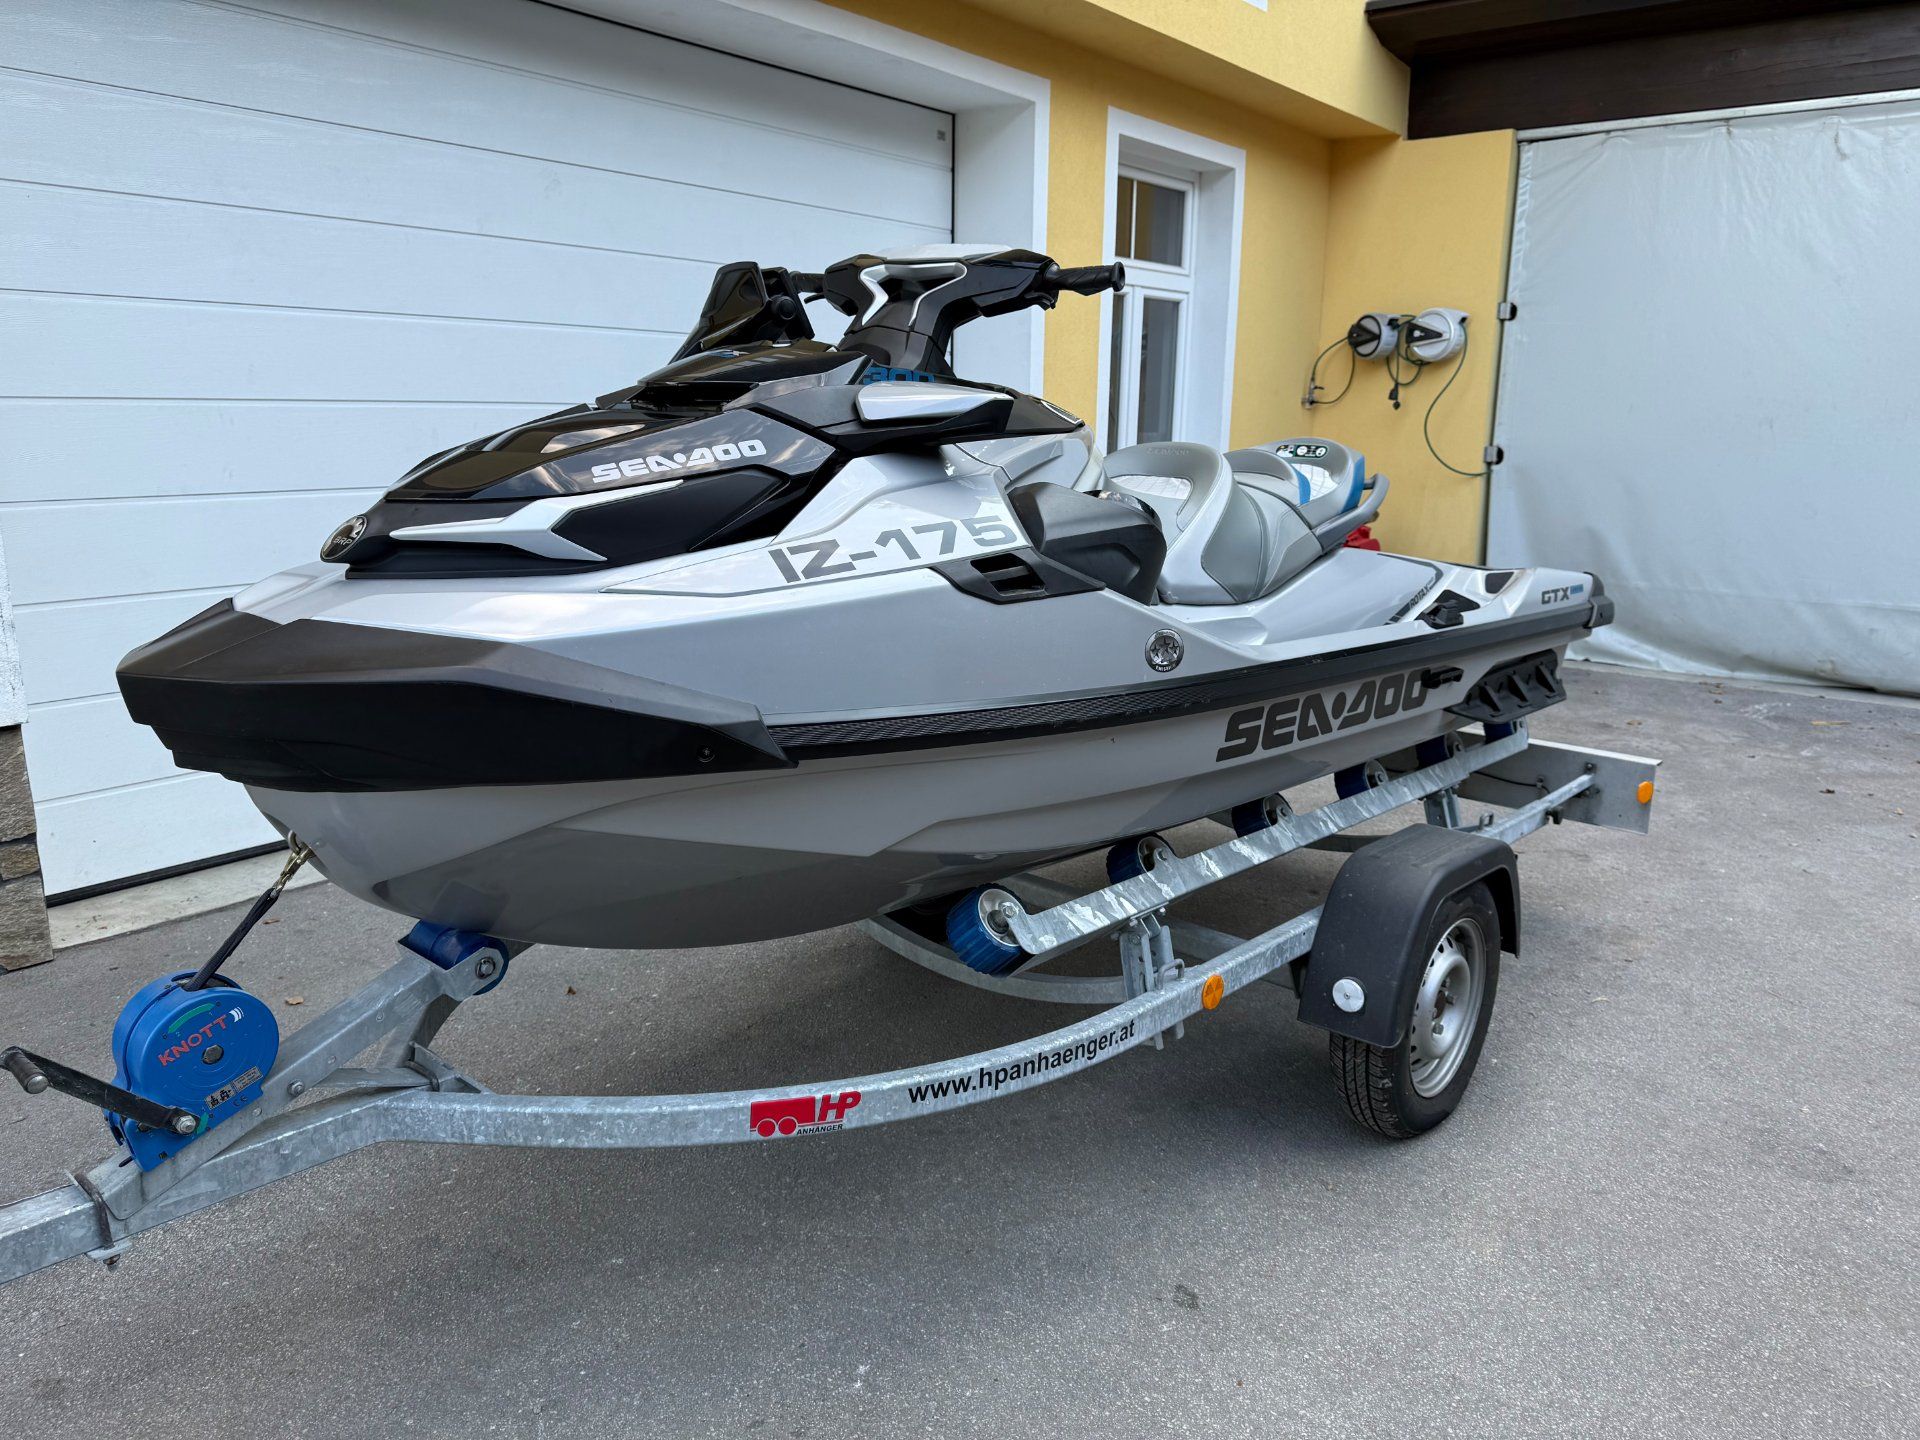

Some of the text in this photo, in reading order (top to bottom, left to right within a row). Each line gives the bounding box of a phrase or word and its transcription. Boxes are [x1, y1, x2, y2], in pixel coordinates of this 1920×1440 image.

[768, 515, 1018, 583] IZ-175
[1409, 584, 1431, 608] ROTAX
[1541, 586, 1570, 605] GTX
[158, 1014, 227, 1066] KNOTT
[908, 1020, 1135, 1103] www.hpanhaenger.at
[818, 1091, 862, 1122] HP
